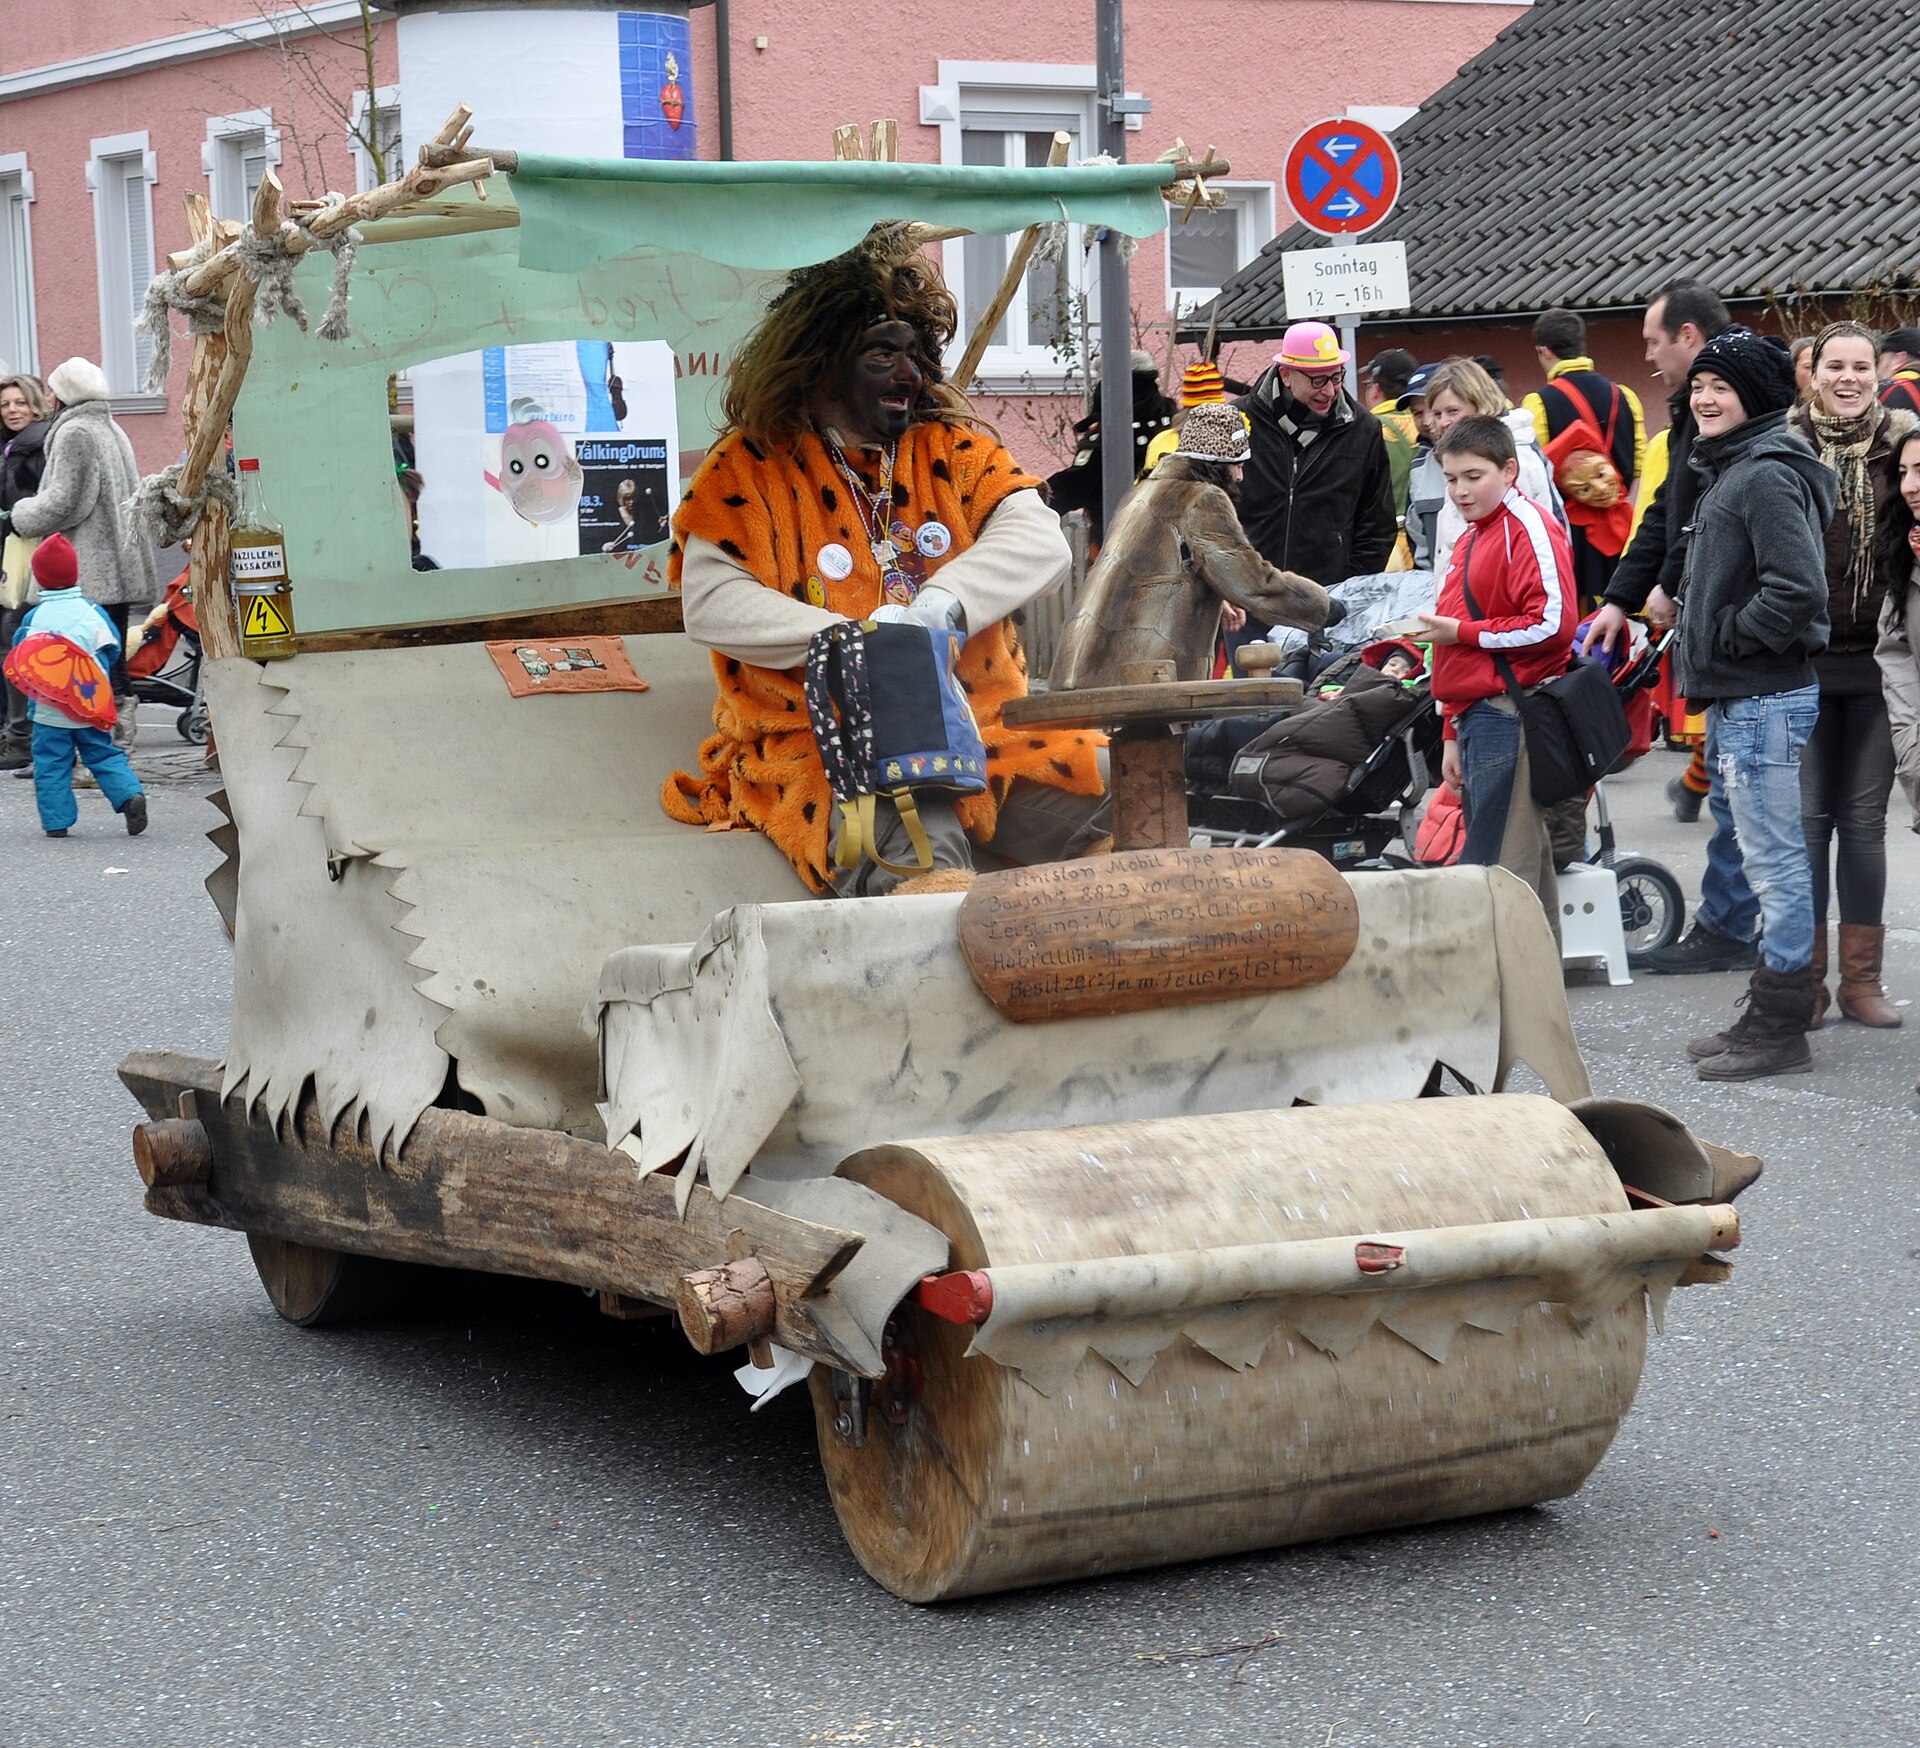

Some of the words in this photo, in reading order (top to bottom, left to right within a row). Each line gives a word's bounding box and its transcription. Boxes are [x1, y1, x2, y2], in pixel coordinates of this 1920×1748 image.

[1314, 258, 1378, 276] Sonntag
[1307, 291, 1324, 307] 12
[576, 443, 666, 463] TalkingDrums
[236, 560, 282, 571] ASSACKER
[1106, 852, 1164, 874] Mobil
[1171, 850, 1215, 869] Type
[1140, 878, 1172, 894] vor
[1181, 870, 1274, 892] Christus
